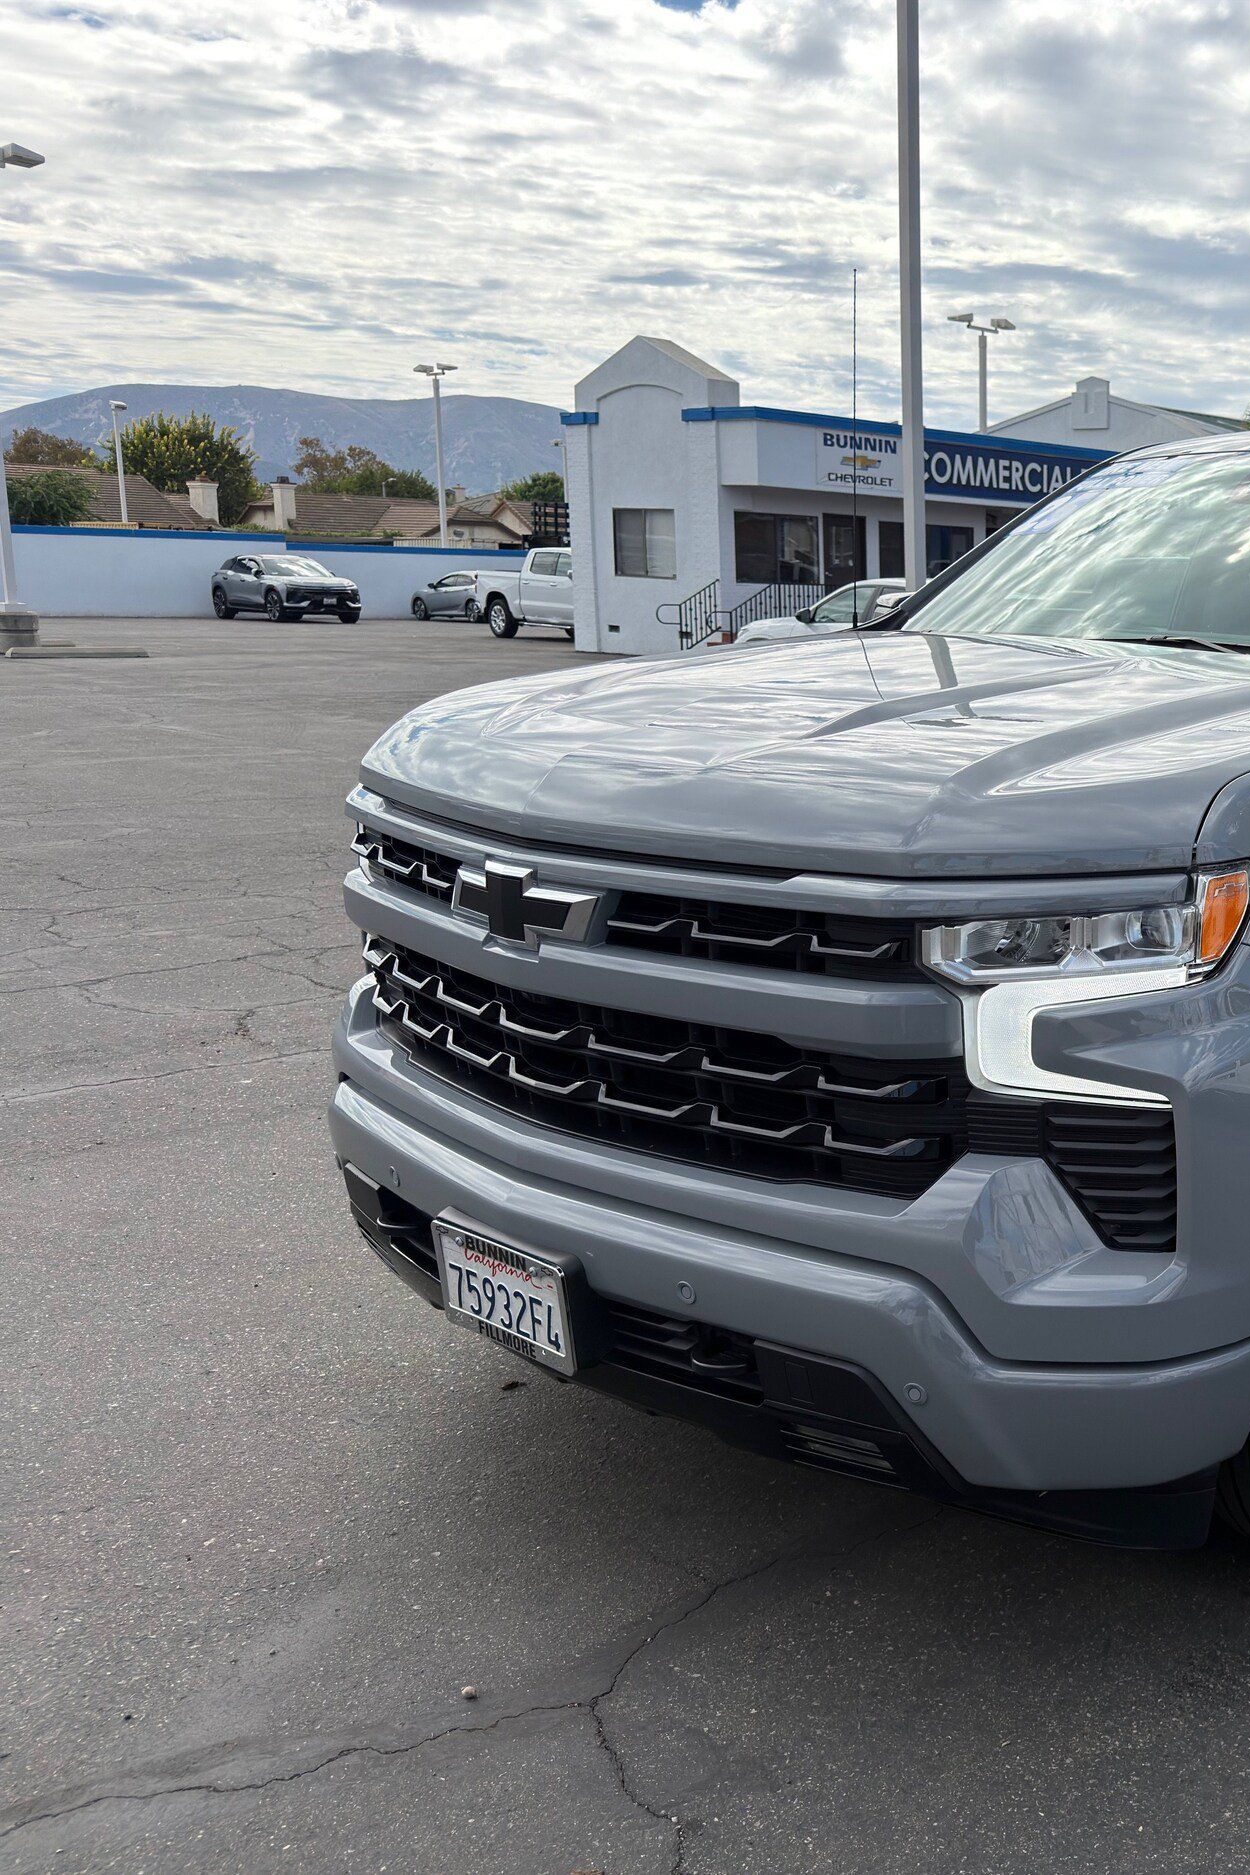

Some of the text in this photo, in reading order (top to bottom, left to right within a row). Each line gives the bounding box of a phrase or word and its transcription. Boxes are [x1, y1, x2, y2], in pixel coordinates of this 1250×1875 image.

[823, 433, 897, 454] BUNNIN
[828, 472, 894, 487] CHEVROLET
[465, 1234, 527, 1272] BUNNIN
[449, 1262, 561, 1352] 75932F4
[479, 1319, 537, 1360] FILLMORE
